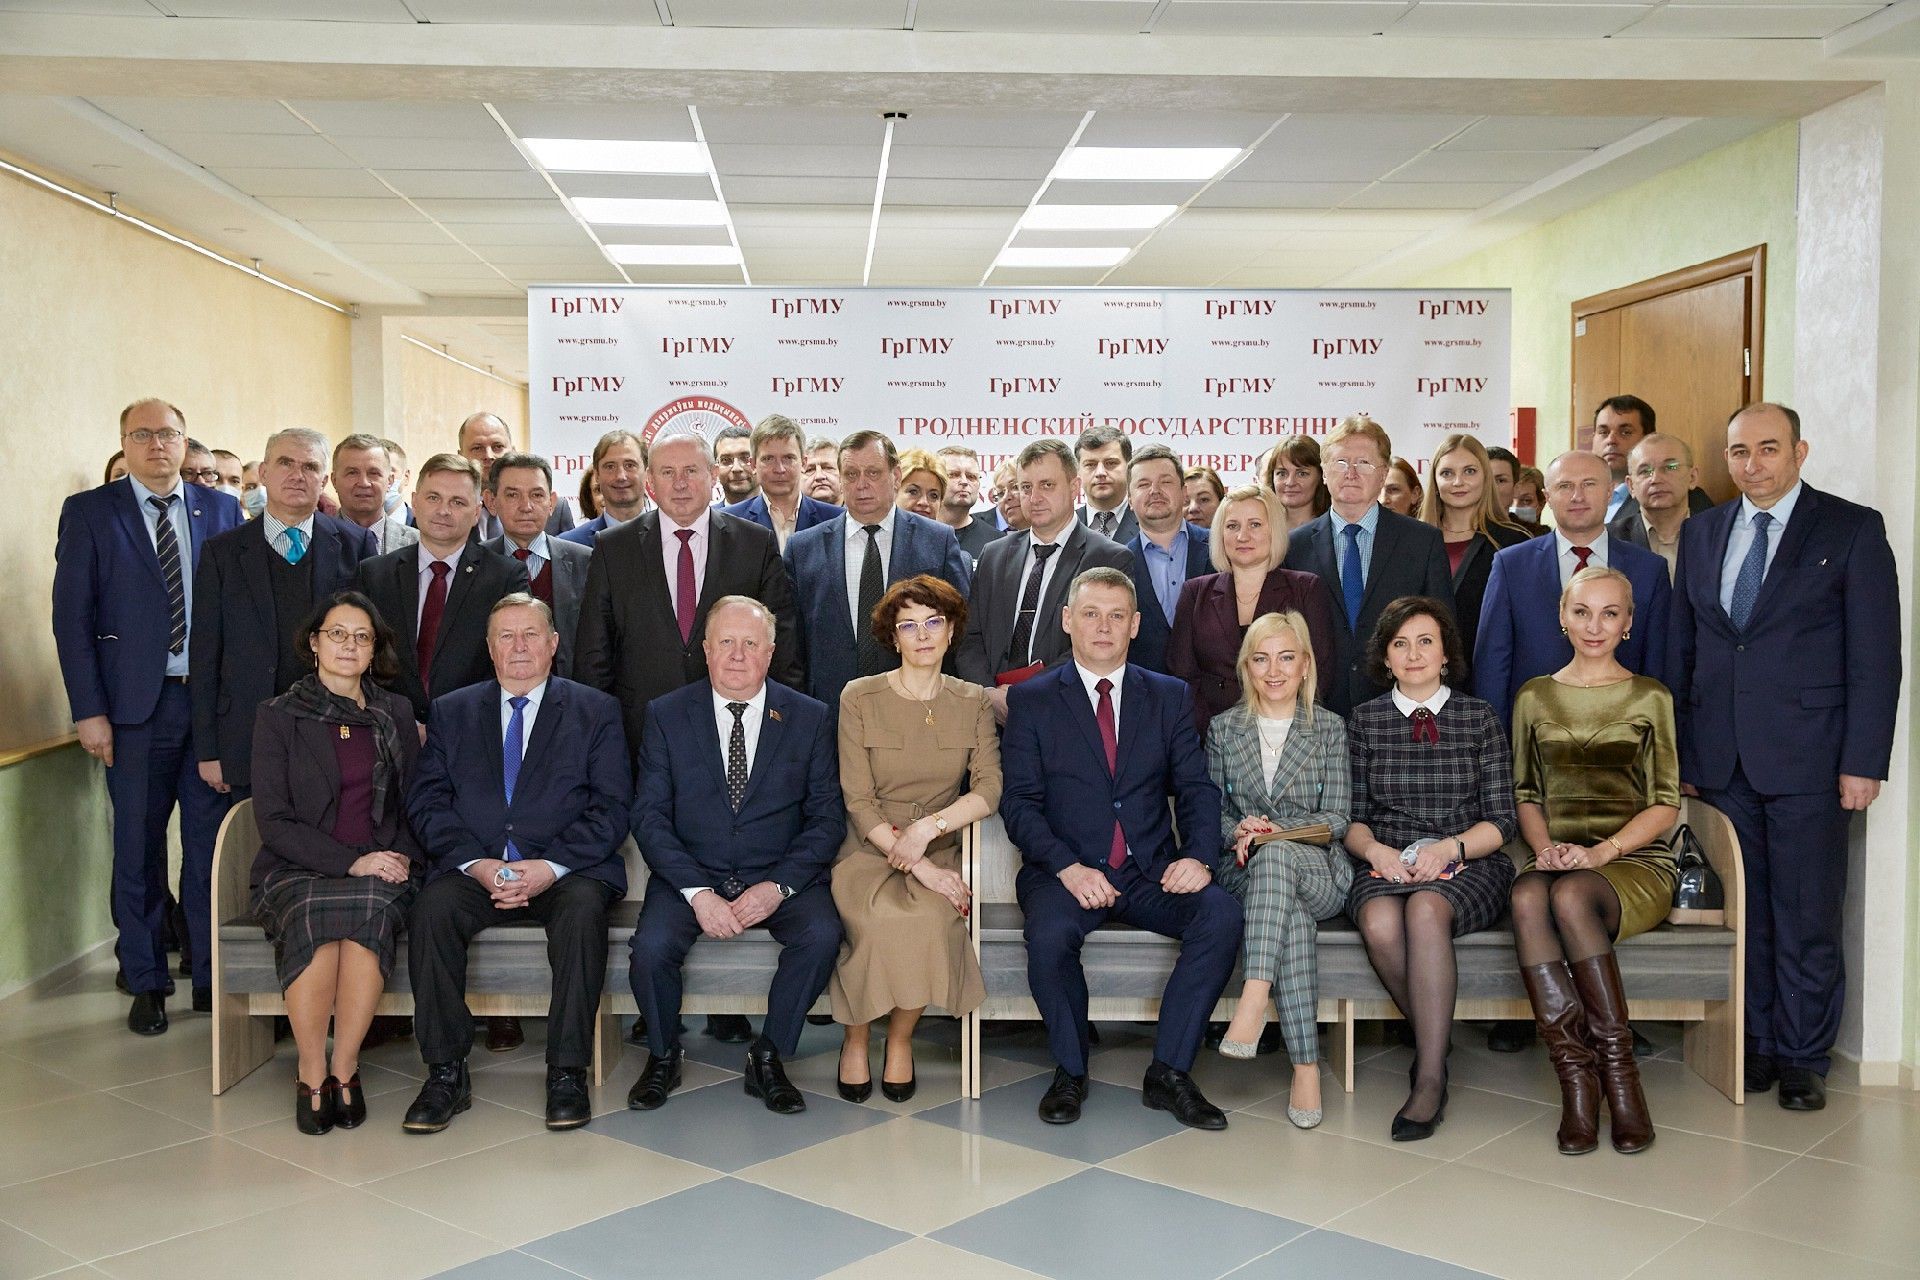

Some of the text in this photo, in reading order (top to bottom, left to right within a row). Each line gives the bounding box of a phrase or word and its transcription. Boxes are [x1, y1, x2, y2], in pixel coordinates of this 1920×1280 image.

[552, 297, 624, 317] ГрГМУ
[668, 297, 727, 308] www.grsmu.by
[771, 298, 844, 318] ГрГМУ
[887, 298, 947, 309] www.grsmu.by
[989, 299, 1061, 319] ГрГМУ
[1103, 299, 1162, 310] www.grsmu.by
[1206, 300, 1276, 319] ГрГМУ
[1318, 299, 1377, 310] www.grsmu.by
[1419, 300, 1489, 319] ГрГМУ
[557, 337, 619, 347] www.grsmu.by
[662, 338, 735, 358] ГрГМУ
[777, 337, 839, 348] www.grsmu.by
[881, 338, 954, 358] ГрГМУ
[995, 338, 1056, 348] www.grsmu.by
[1098, 339, 1169, 359] ГрГМУ
[1211, 338, 1271, 349] www.grsmu.by
[1313, 339, 1383, 359] ГрГМУ
[1423, 338, 1482, 348] www.grsmu.by
[552, 377, 625, 397] ГрГМУ
[668, 378, 729, 389] www.grsmu.by
[771, 377, 844, 397] ГрГМУ
[887, 379, 947, 389] www.grsmu.by
[990, 378, 1061, 397] ГрГМУ
[1103, 379, 1163, 389] www.grsmu.by
[1206, 378, 1276, 397] ГрГМУ
[1318, 379, 1376, 389] www.grsmu.by
[1417, 378, 1488, 397] ГрГМУ
[558, 413, 620, 424] www.grsmu.by
[897, 412, 1368, 440] ГРОДНЕНСКИЙ ГОСУДАРСТВЕНН
[1423, 420, 1480, 431] www.grsmu.by
